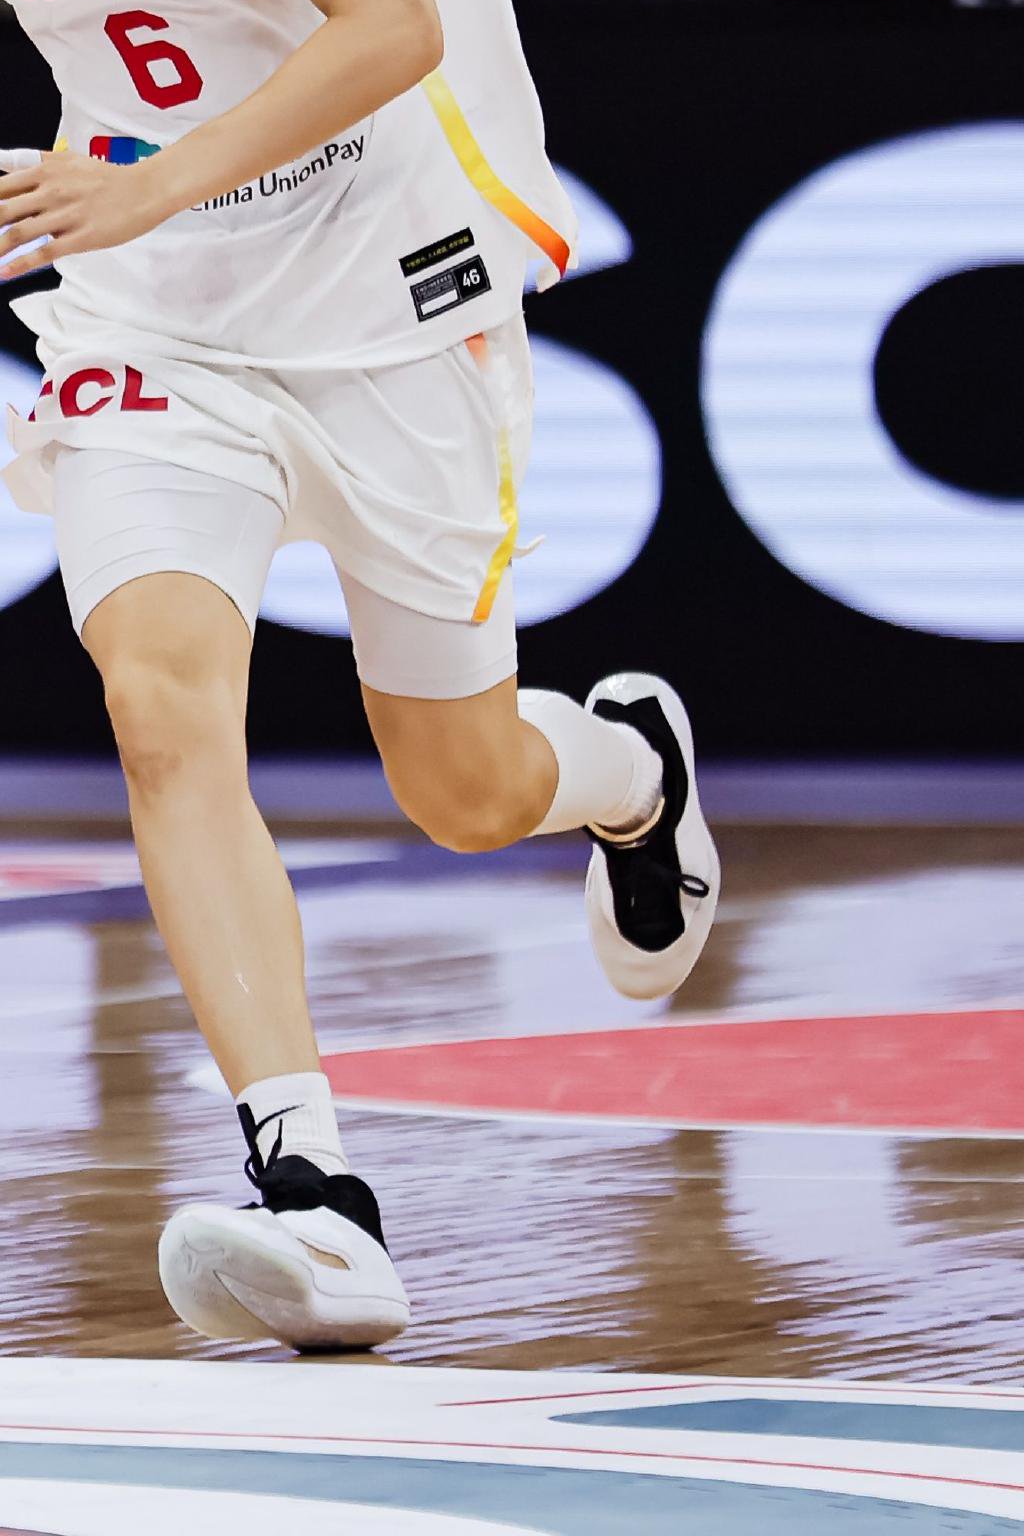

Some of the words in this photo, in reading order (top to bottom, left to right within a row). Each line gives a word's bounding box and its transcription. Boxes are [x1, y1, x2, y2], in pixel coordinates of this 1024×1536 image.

[104, 10, 203, 109] 6
[259, 135, 364, 197] UnionPay
[463, 268, 480, 287] 46
